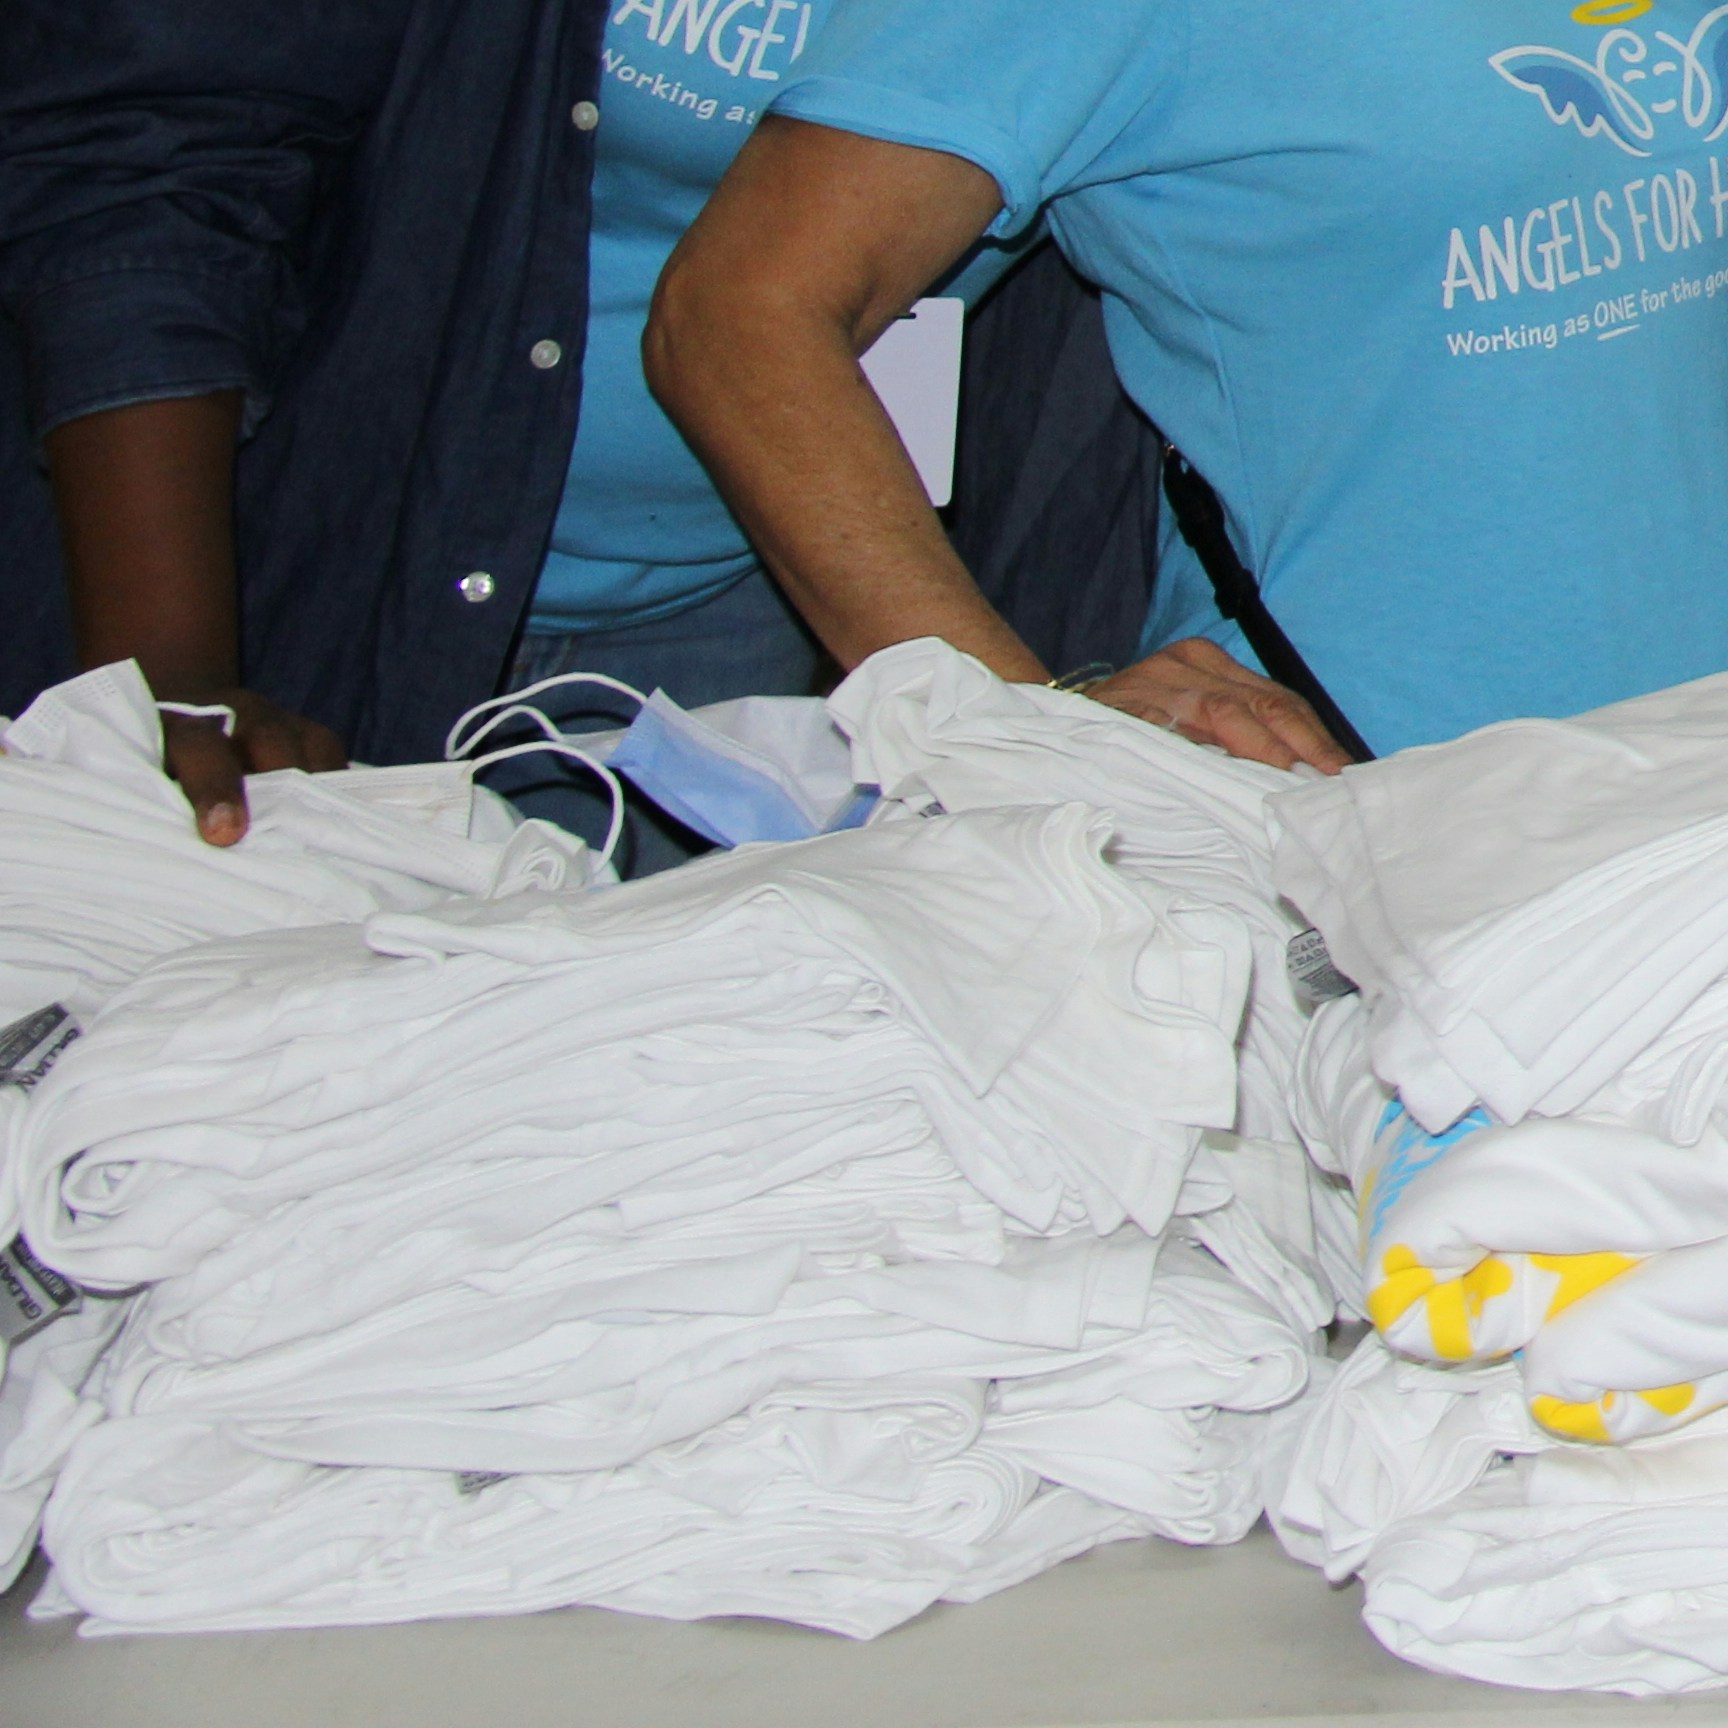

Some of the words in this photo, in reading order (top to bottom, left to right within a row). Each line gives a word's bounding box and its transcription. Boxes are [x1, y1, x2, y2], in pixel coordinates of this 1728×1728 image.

[1442, 190, 1621, 309] ANGELS
[1623, 168, 1702, 262] FOR
[1447, 321, 1559, 356] Working
[1563, 312, 1590, 335] as
[1593, 292, 1639, 327] ONE
[1640, 288, 1668, 313] for
[1669, 278, 1701, 305] the
